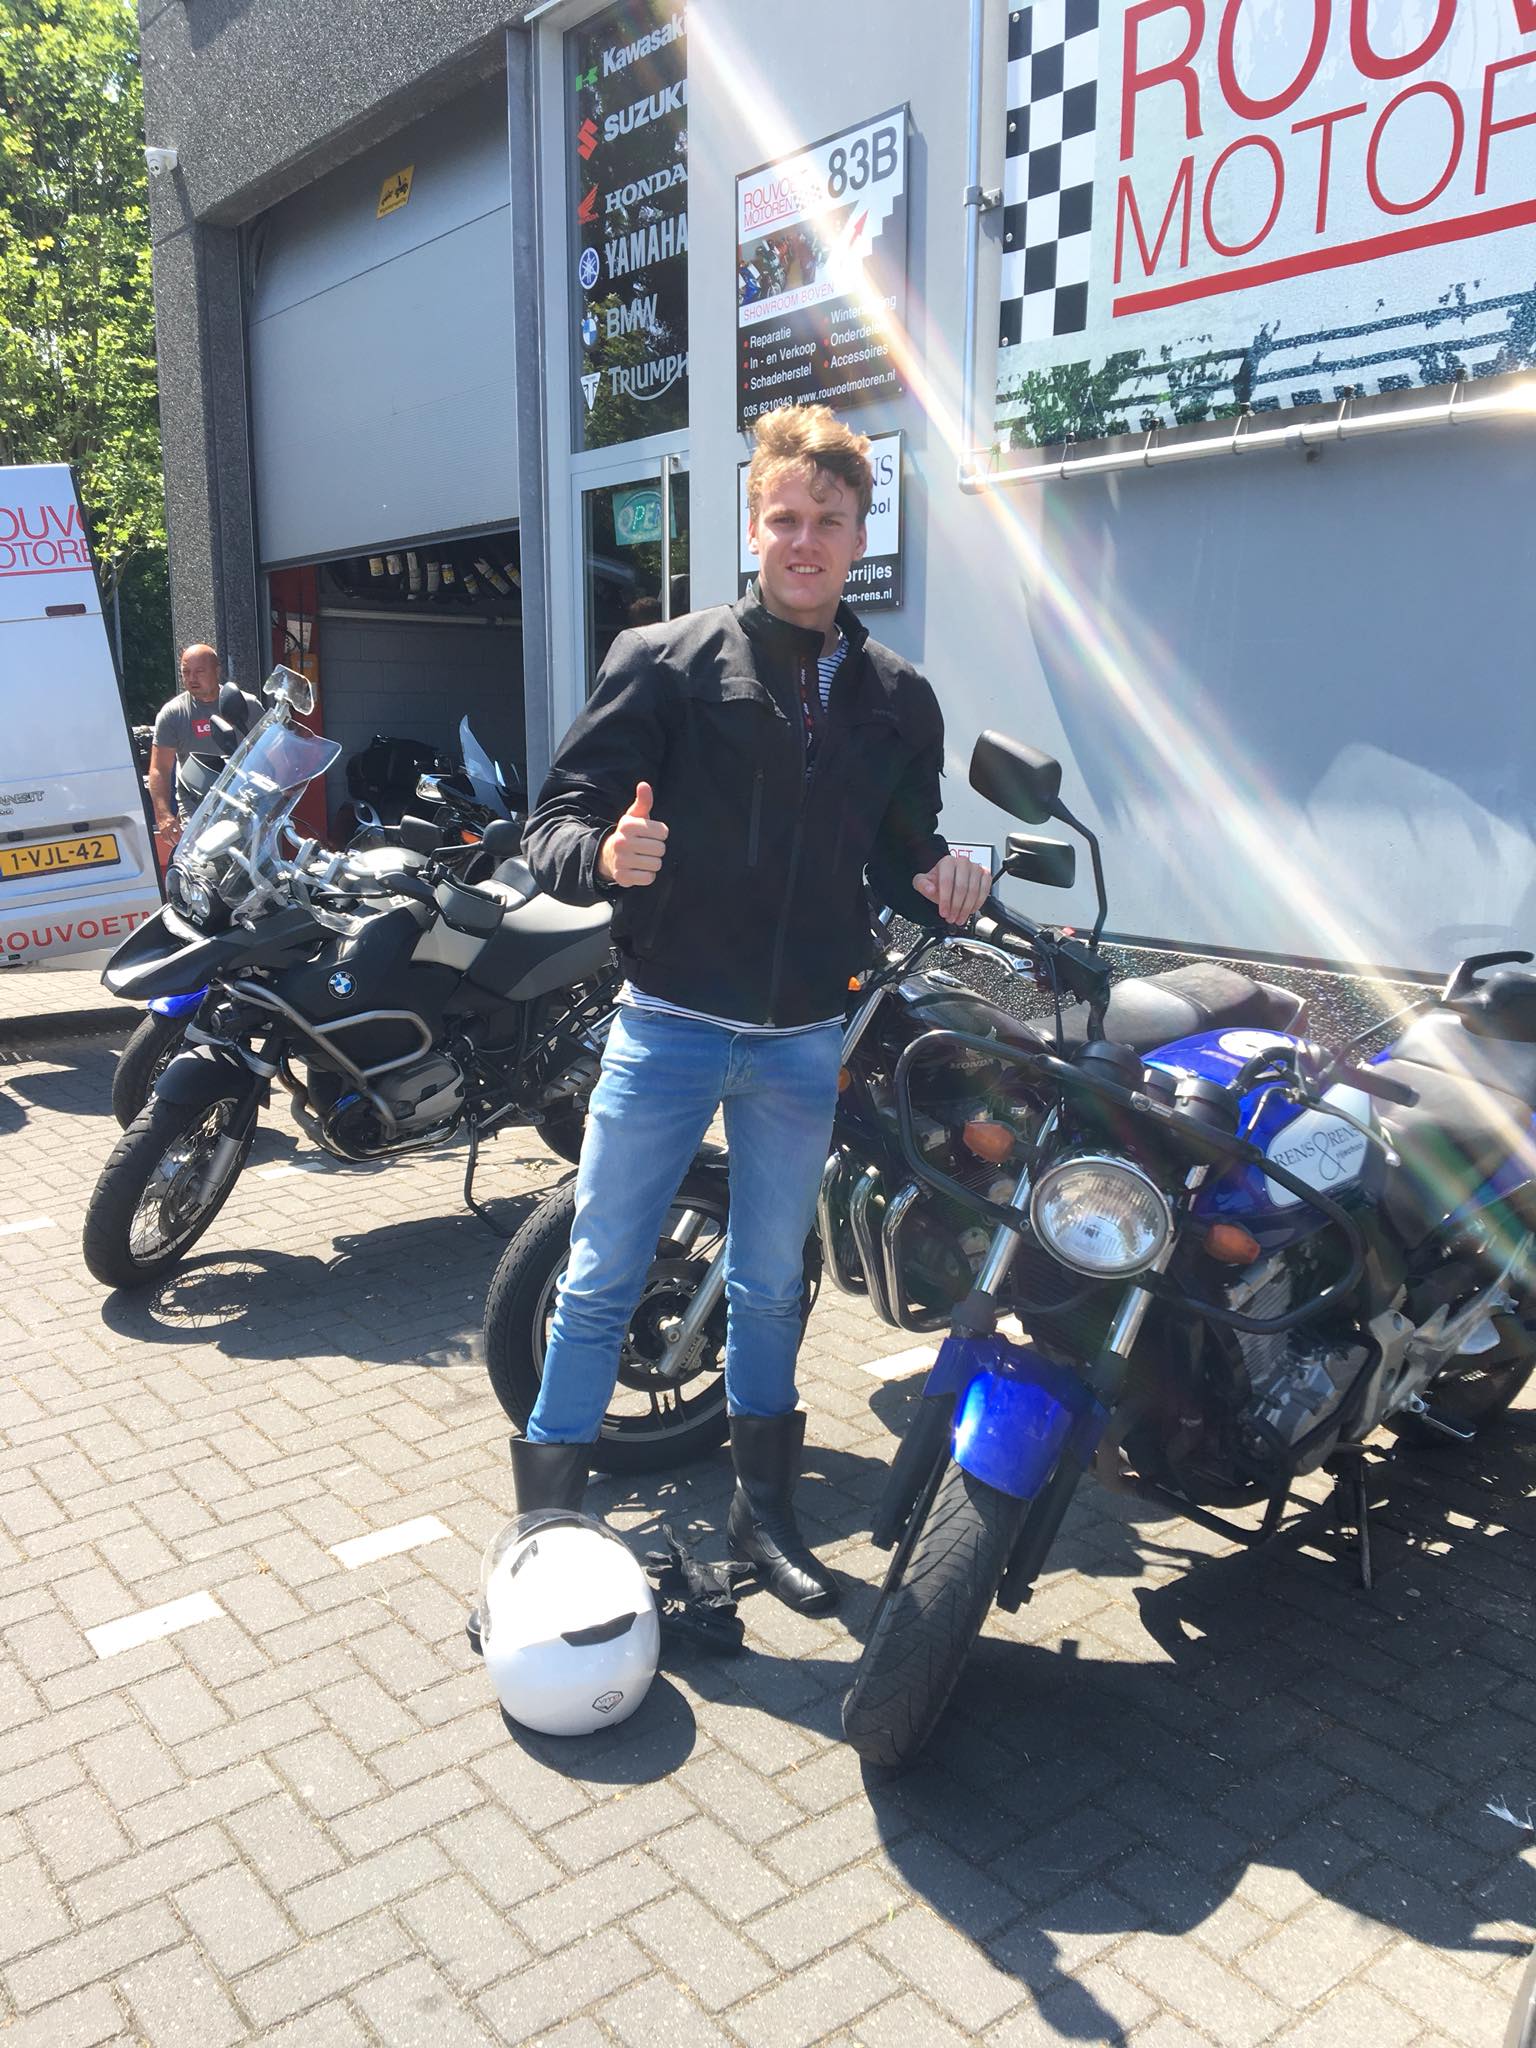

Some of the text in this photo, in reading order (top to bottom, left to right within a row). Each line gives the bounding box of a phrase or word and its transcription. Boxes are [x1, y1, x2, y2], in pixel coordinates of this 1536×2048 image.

[827, 126, 898, 199] 83B
[605, 163, 688, 214] HONDA
[605, 212, 688, 280] YAMAHA
[606, 293, 658, 339] BMW
[743, 283, 834, 321] SHOWROOM BOVEN
[750, 326, 792, 349] Reparatie
[750, 356, 759, 370] In
[766, 352, 778, 366] en
[780, 341, 817, 361] Verkoop
[830, 343, 889, 369] Accessoires
[608, 352, 689, 400] TRIUMPH
[750, 362, 812, 391] Schadeherstel
[743, 403, 758, 418] 035
[11, 841, 105, 870] 1-VJL-42
[1273, 1141, 1317, 1167] RENS
